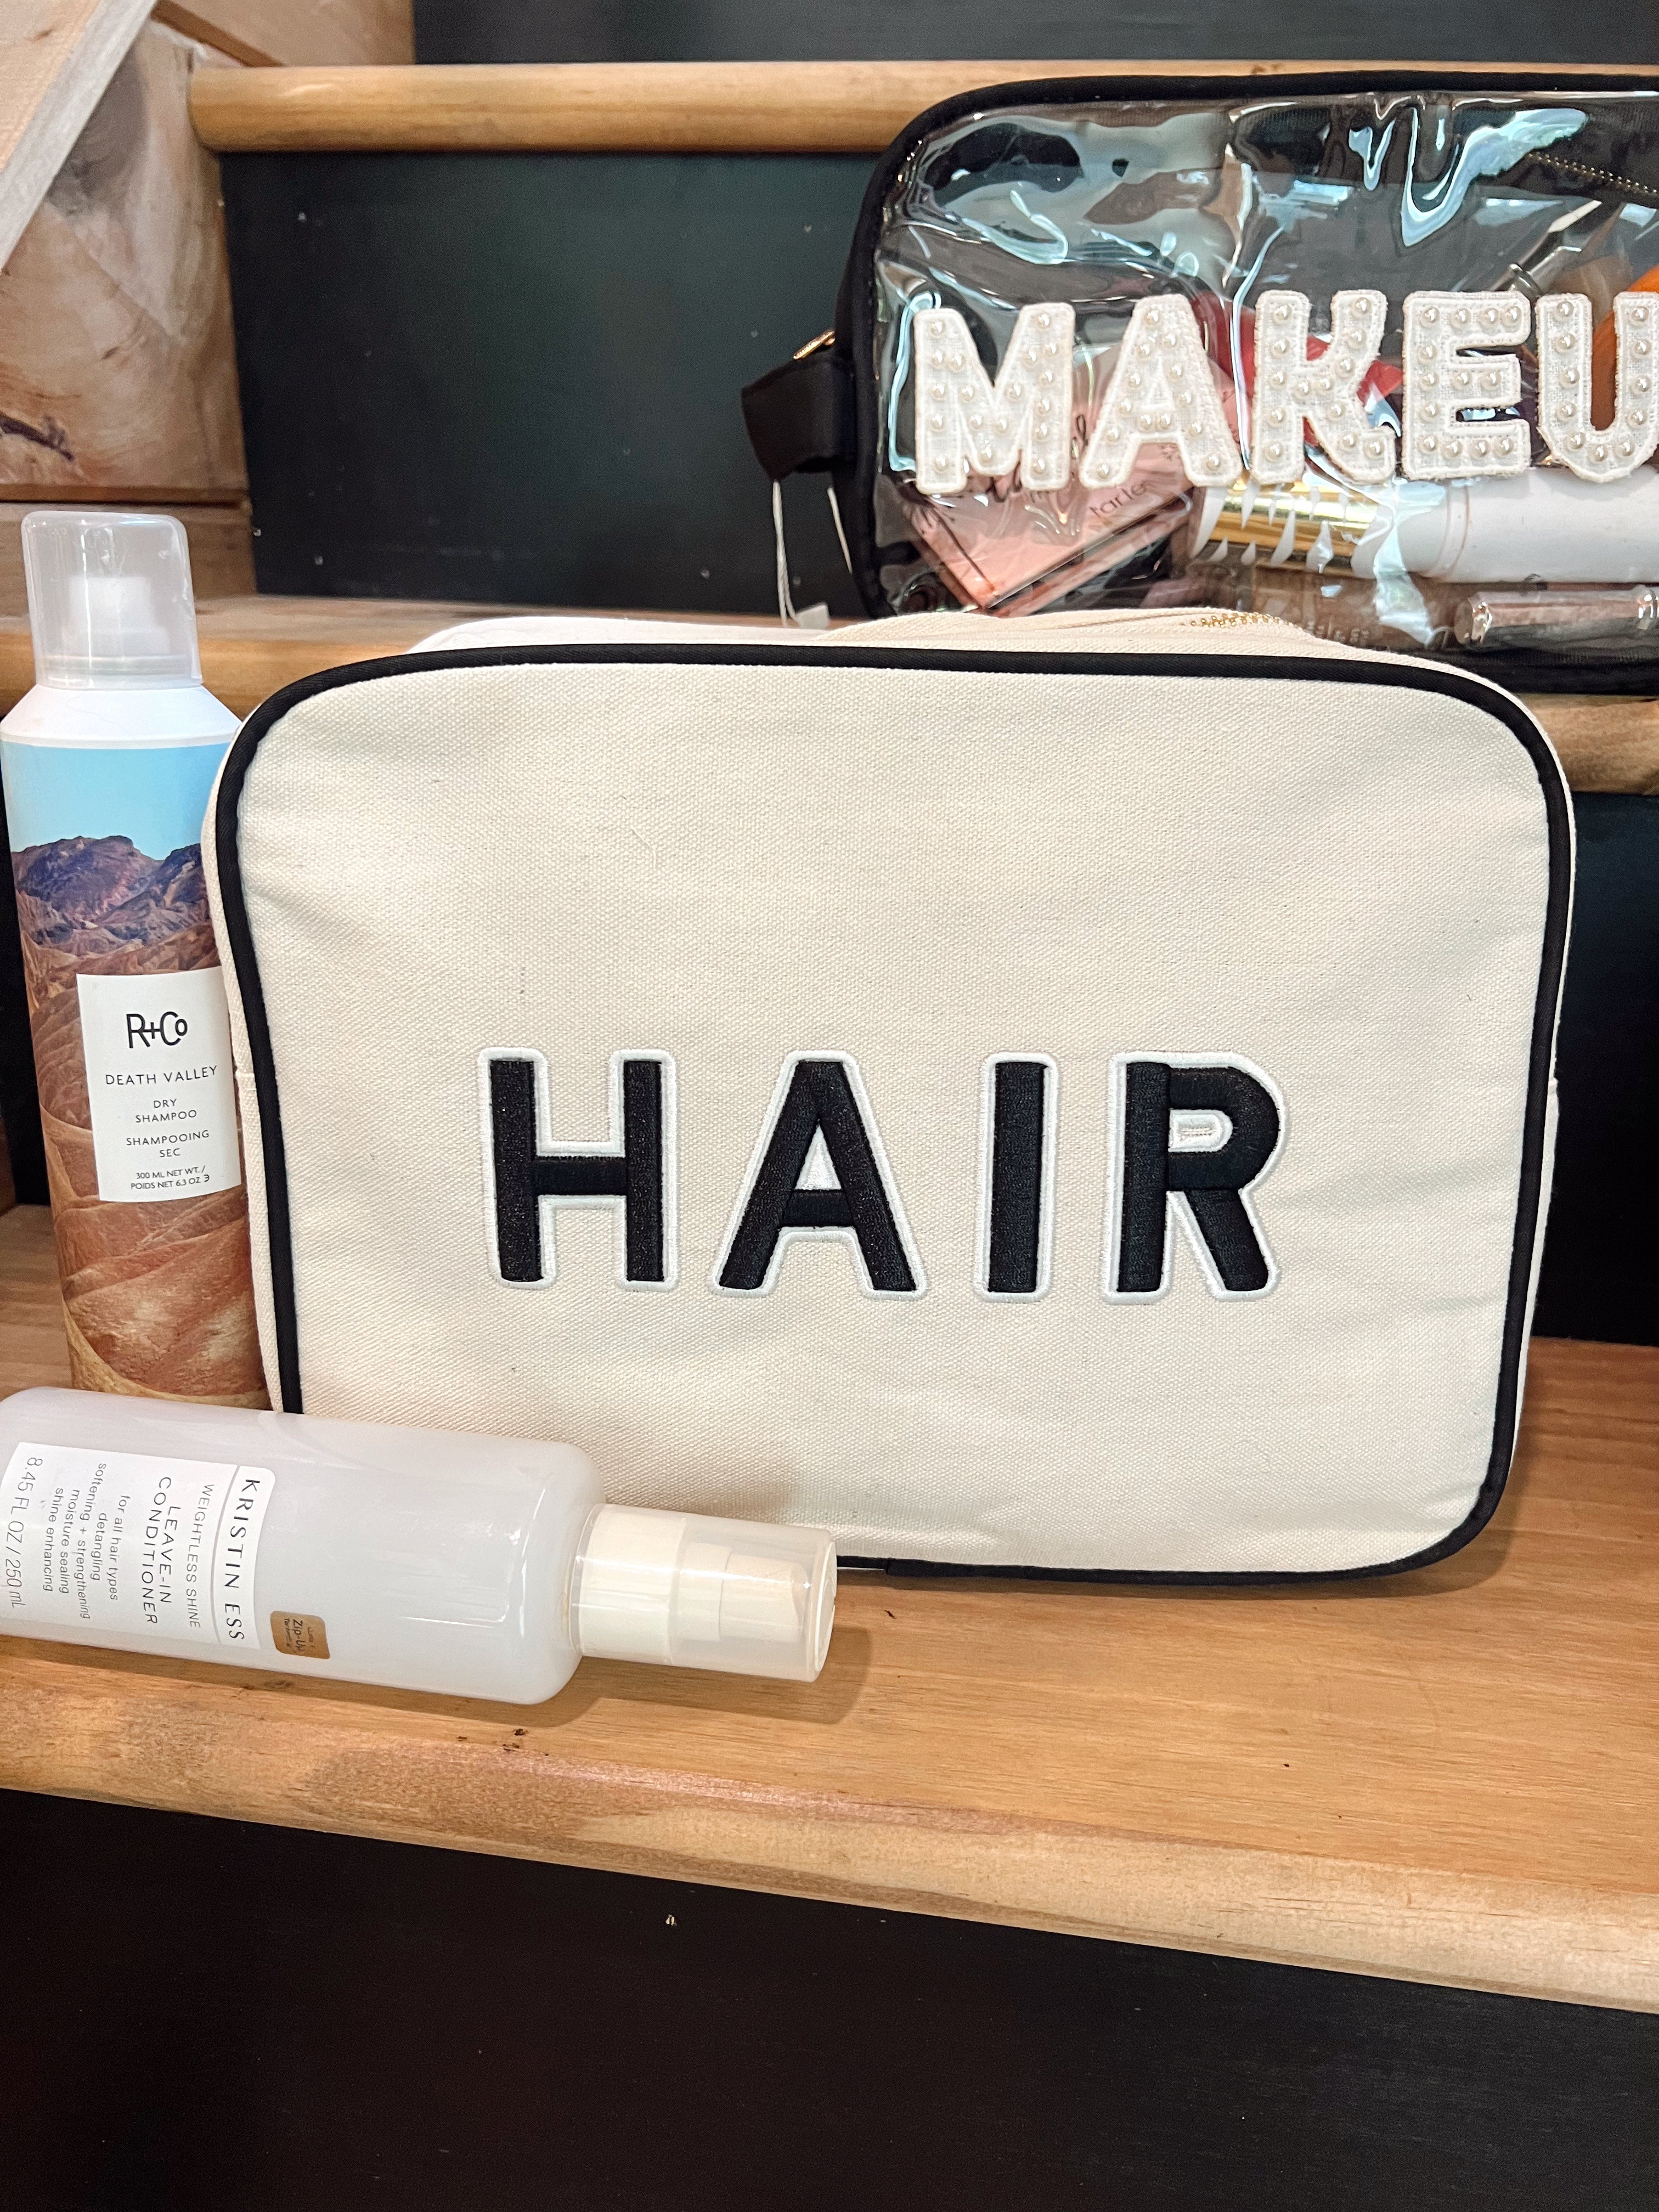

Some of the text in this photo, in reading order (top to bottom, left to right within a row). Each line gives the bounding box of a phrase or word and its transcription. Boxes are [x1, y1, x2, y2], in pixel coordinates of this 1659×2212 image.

[126, 1011, 188, 1048] R+Co
[105, 1065, 217, 1085] DEATH VALLEY
[136, 1110, 197, 1123] SHAMPOO
[153, 1098, 177, 1108] DRY
[126, 1130, 209, 1146] SHAMPOOING
[159, 1148, 180, 1158] SEC
[482, 1052, 1284, 1299] HAIR
[18, 1457, 43, 1491] 8.45
[80, 1463, 106, 1521] softening
[11, 1497, 29, 1514] FL
[7, 1521, 24, 1543] OZ
[43, 1488, 64, 1592] shine enhancing
[59, 1489, 80, 1594] moisture sealing
[90, 1513, 108, 1581] detangling
[106, 1496, 131, 1600] for all hair types
[142, 1477, 172, 1624] CONDITIONER
[159, 1506, 181, 1603] LEAVE-IN
[5, 1559, 22, 1587] 250
[74, 1540, 90, 1619] strengthening
[186, 1484, 215, 1628] WEIGHTLESS SHINE
[224, 1479, 260, 1640] KRISTIN ESS
[9, 1591, 26, 1608] mL
